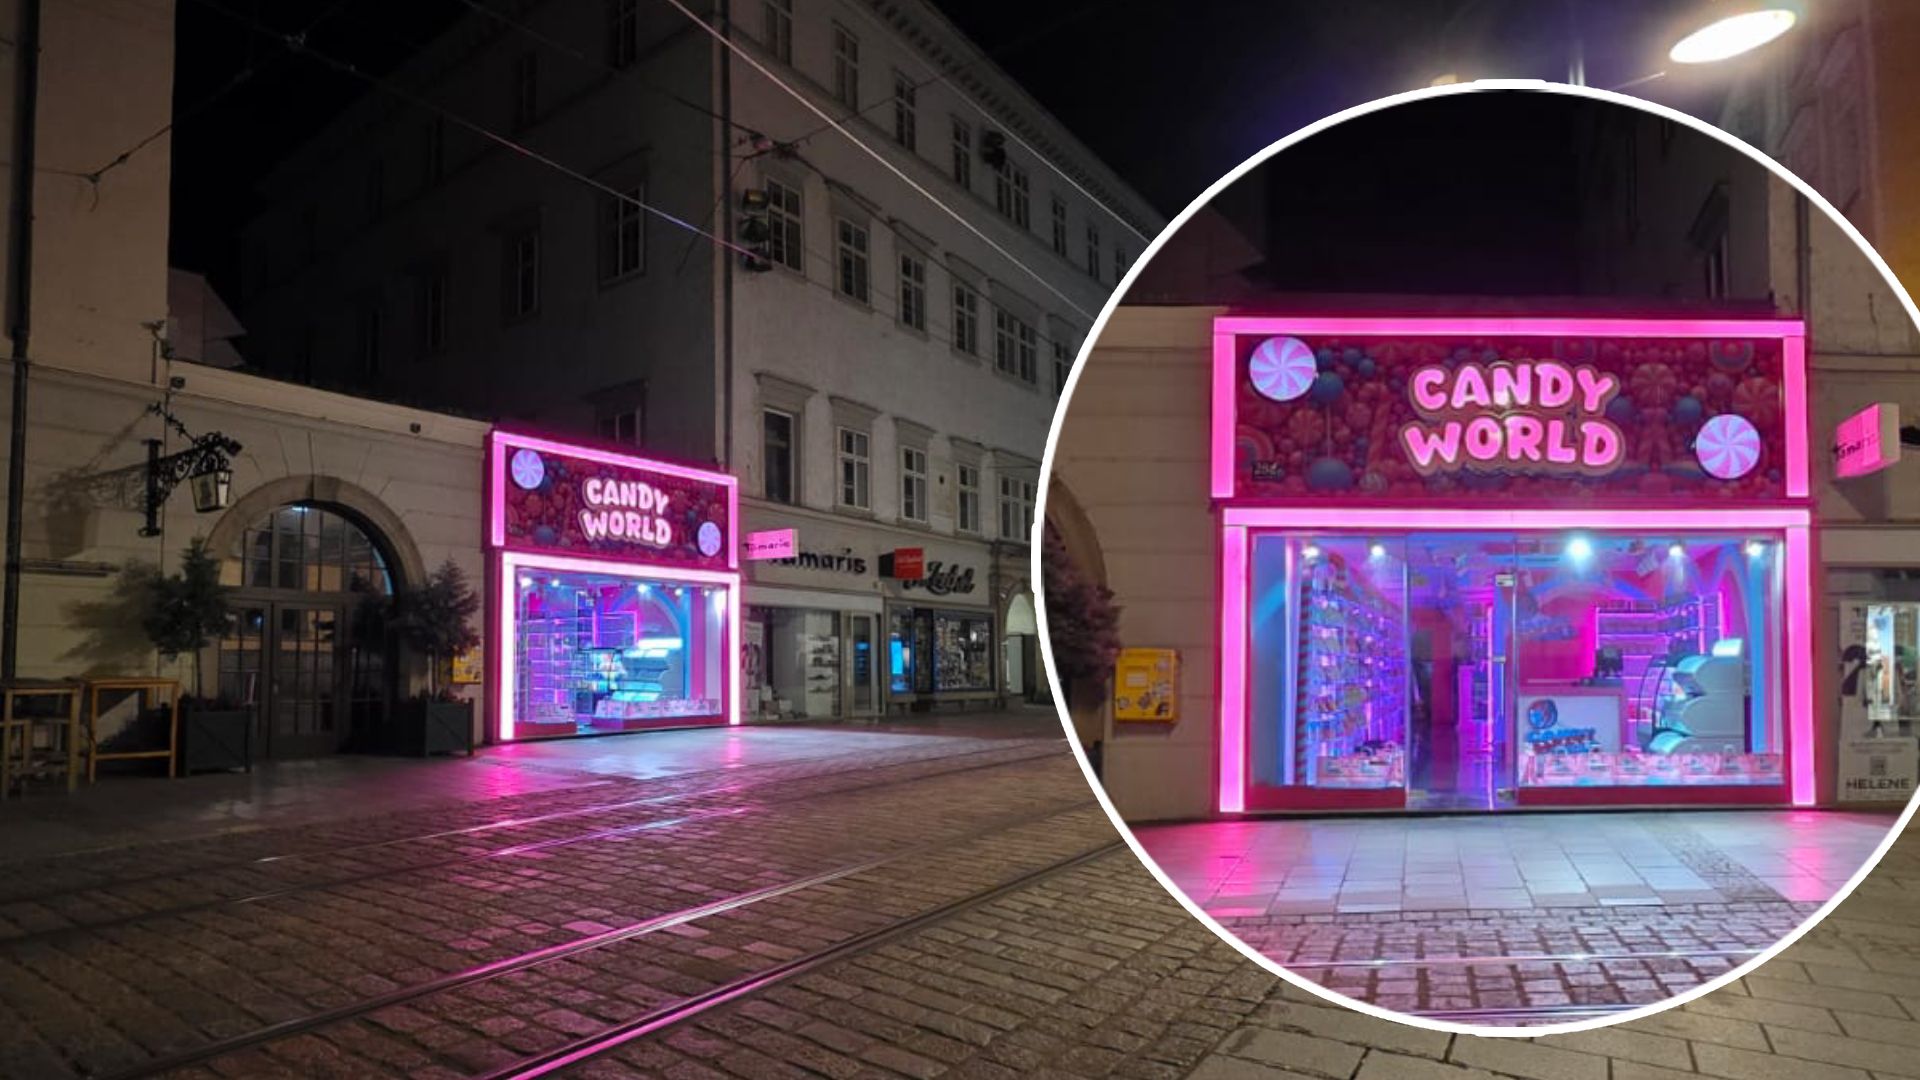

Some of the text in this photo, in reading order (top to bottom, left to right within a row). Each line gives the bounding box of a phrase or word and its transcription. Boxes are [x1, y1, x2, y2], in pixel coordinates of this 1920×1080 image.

[1413, 363, 1614, 412] CANDY
[1404, 416, 1619, 467] WORLD
[586, 478, 670, 516] CANDY
[581, 511, 673, 545] WORLD
[1845, 778, 1910, 790] HELENE
